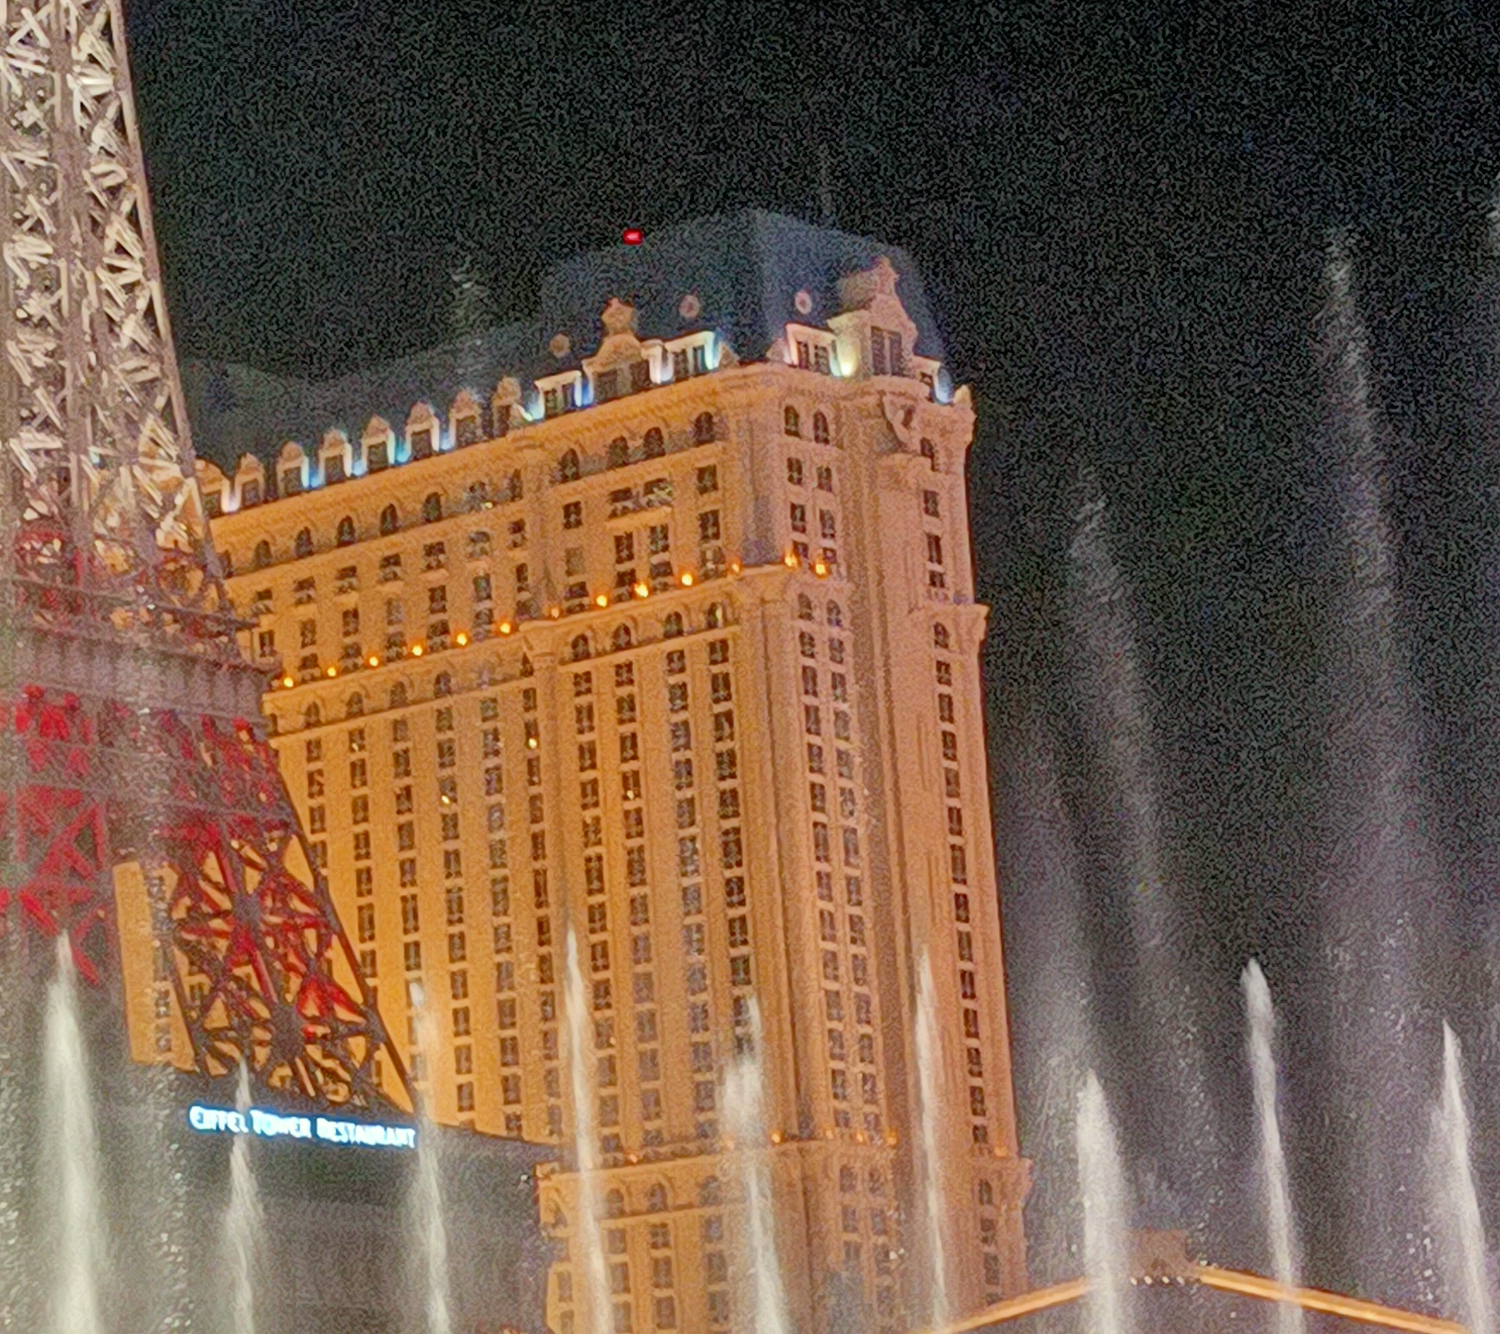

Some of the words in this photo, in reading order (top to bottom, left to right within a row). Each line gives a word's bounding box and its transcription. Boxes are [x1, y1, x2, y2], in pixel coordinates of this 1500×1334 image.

[189, 1105, 248, 1133] EIFFEL
[250, 1109, 311, 1138] TOWER
[316, 1118, 416, 1148] RESTAURANT
